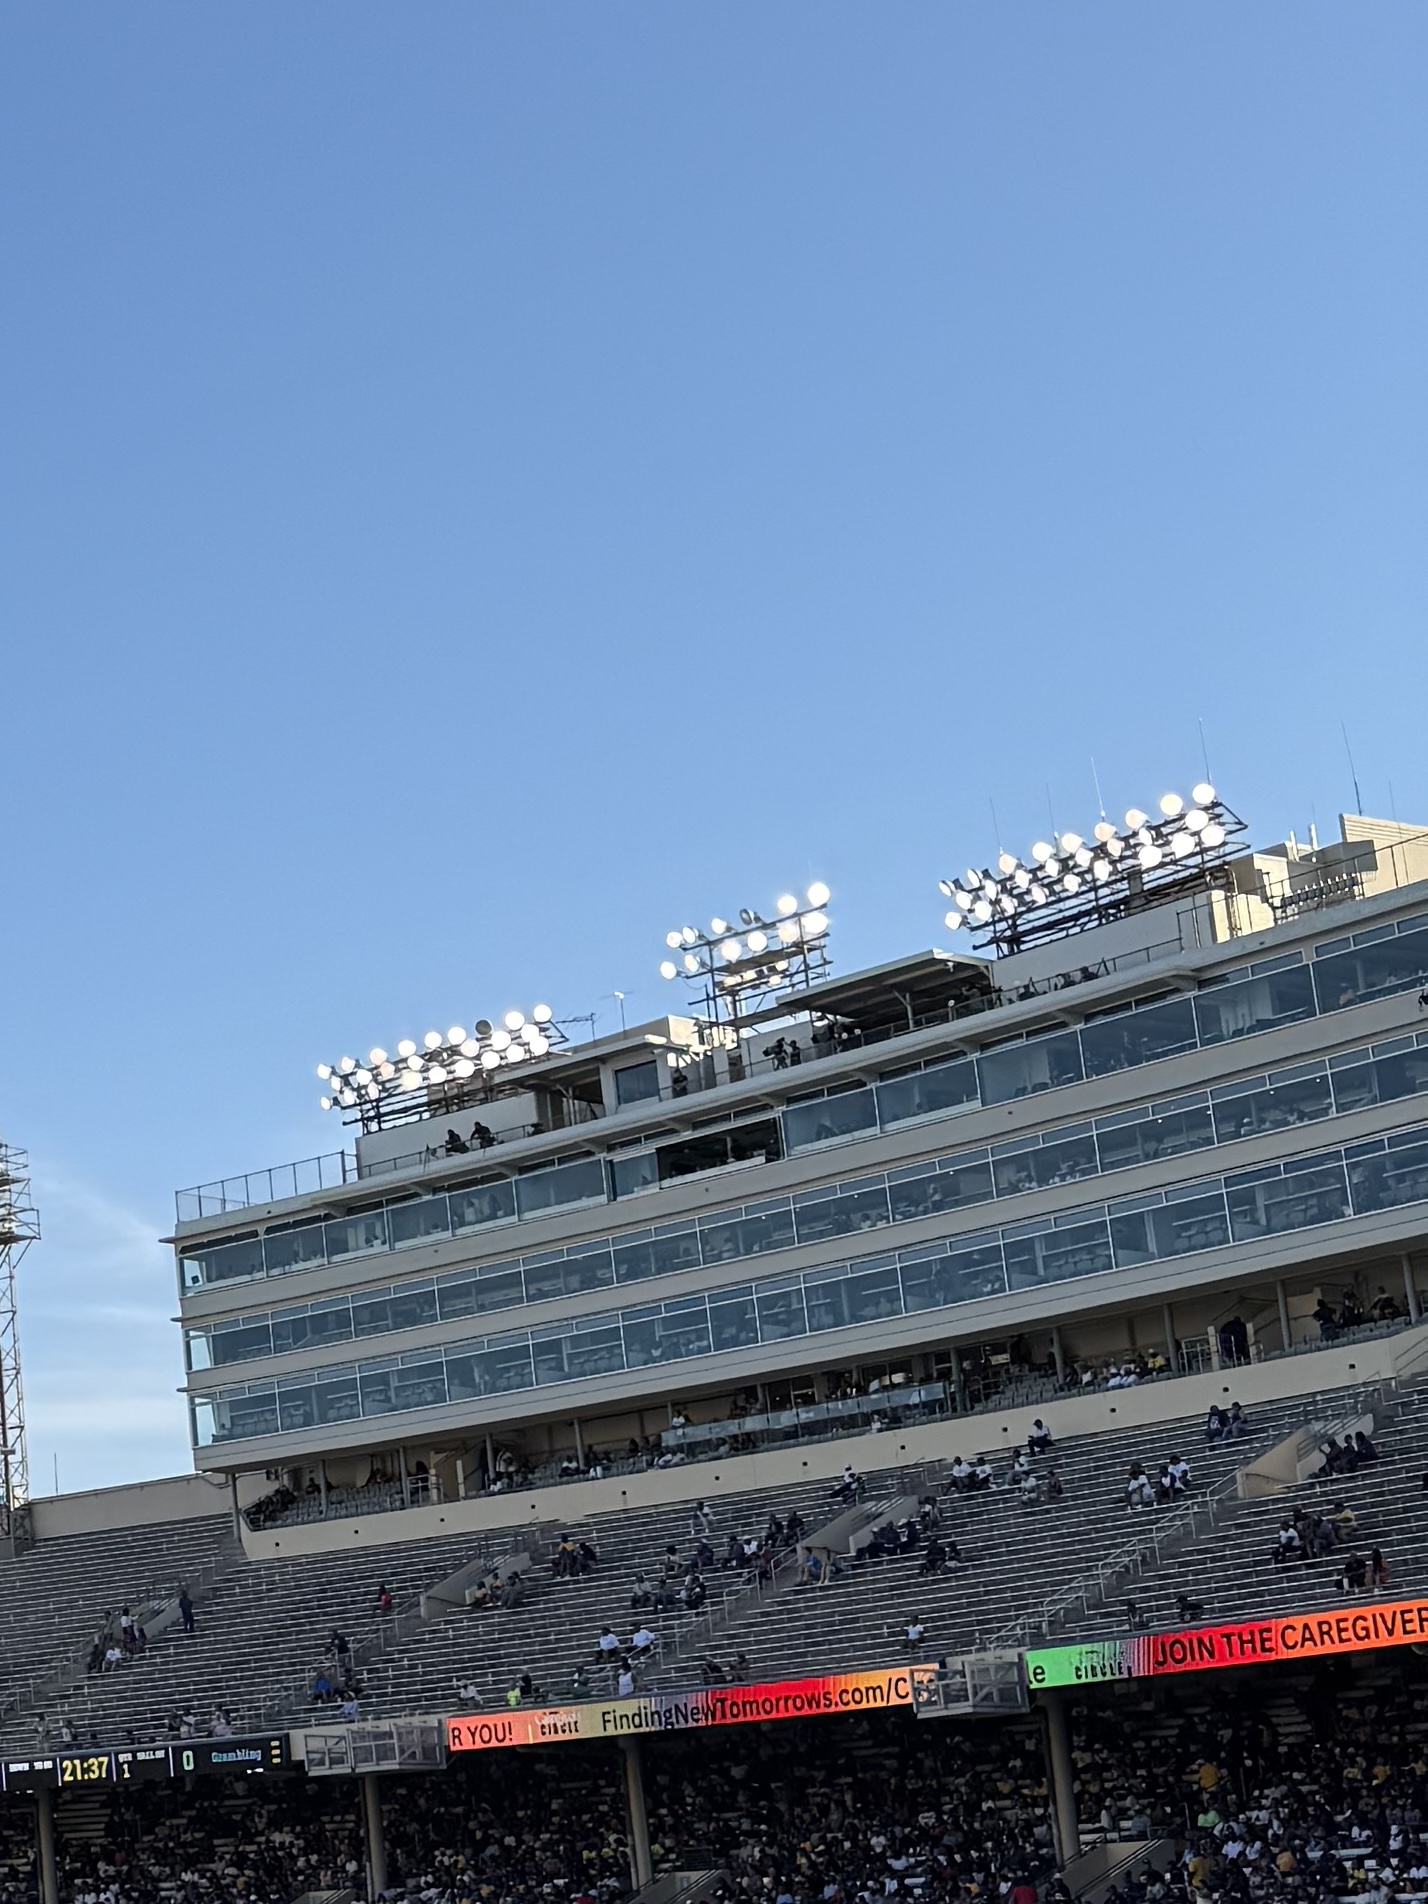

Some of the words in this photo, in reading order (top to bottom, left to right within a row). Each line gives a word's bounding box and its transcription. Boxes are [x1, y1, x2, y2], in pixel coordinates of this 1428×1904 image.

[1154, 1637, 1216, 1668] JOIN
[1221, 1631, 1276, 1657] THE
[466, 1721, 513, 1745] YOU!
[62, 1756, 109, 1782] 21:37
[122, 1763, 131, 1779] 1
[182, 1750, 195, 1771] 0
